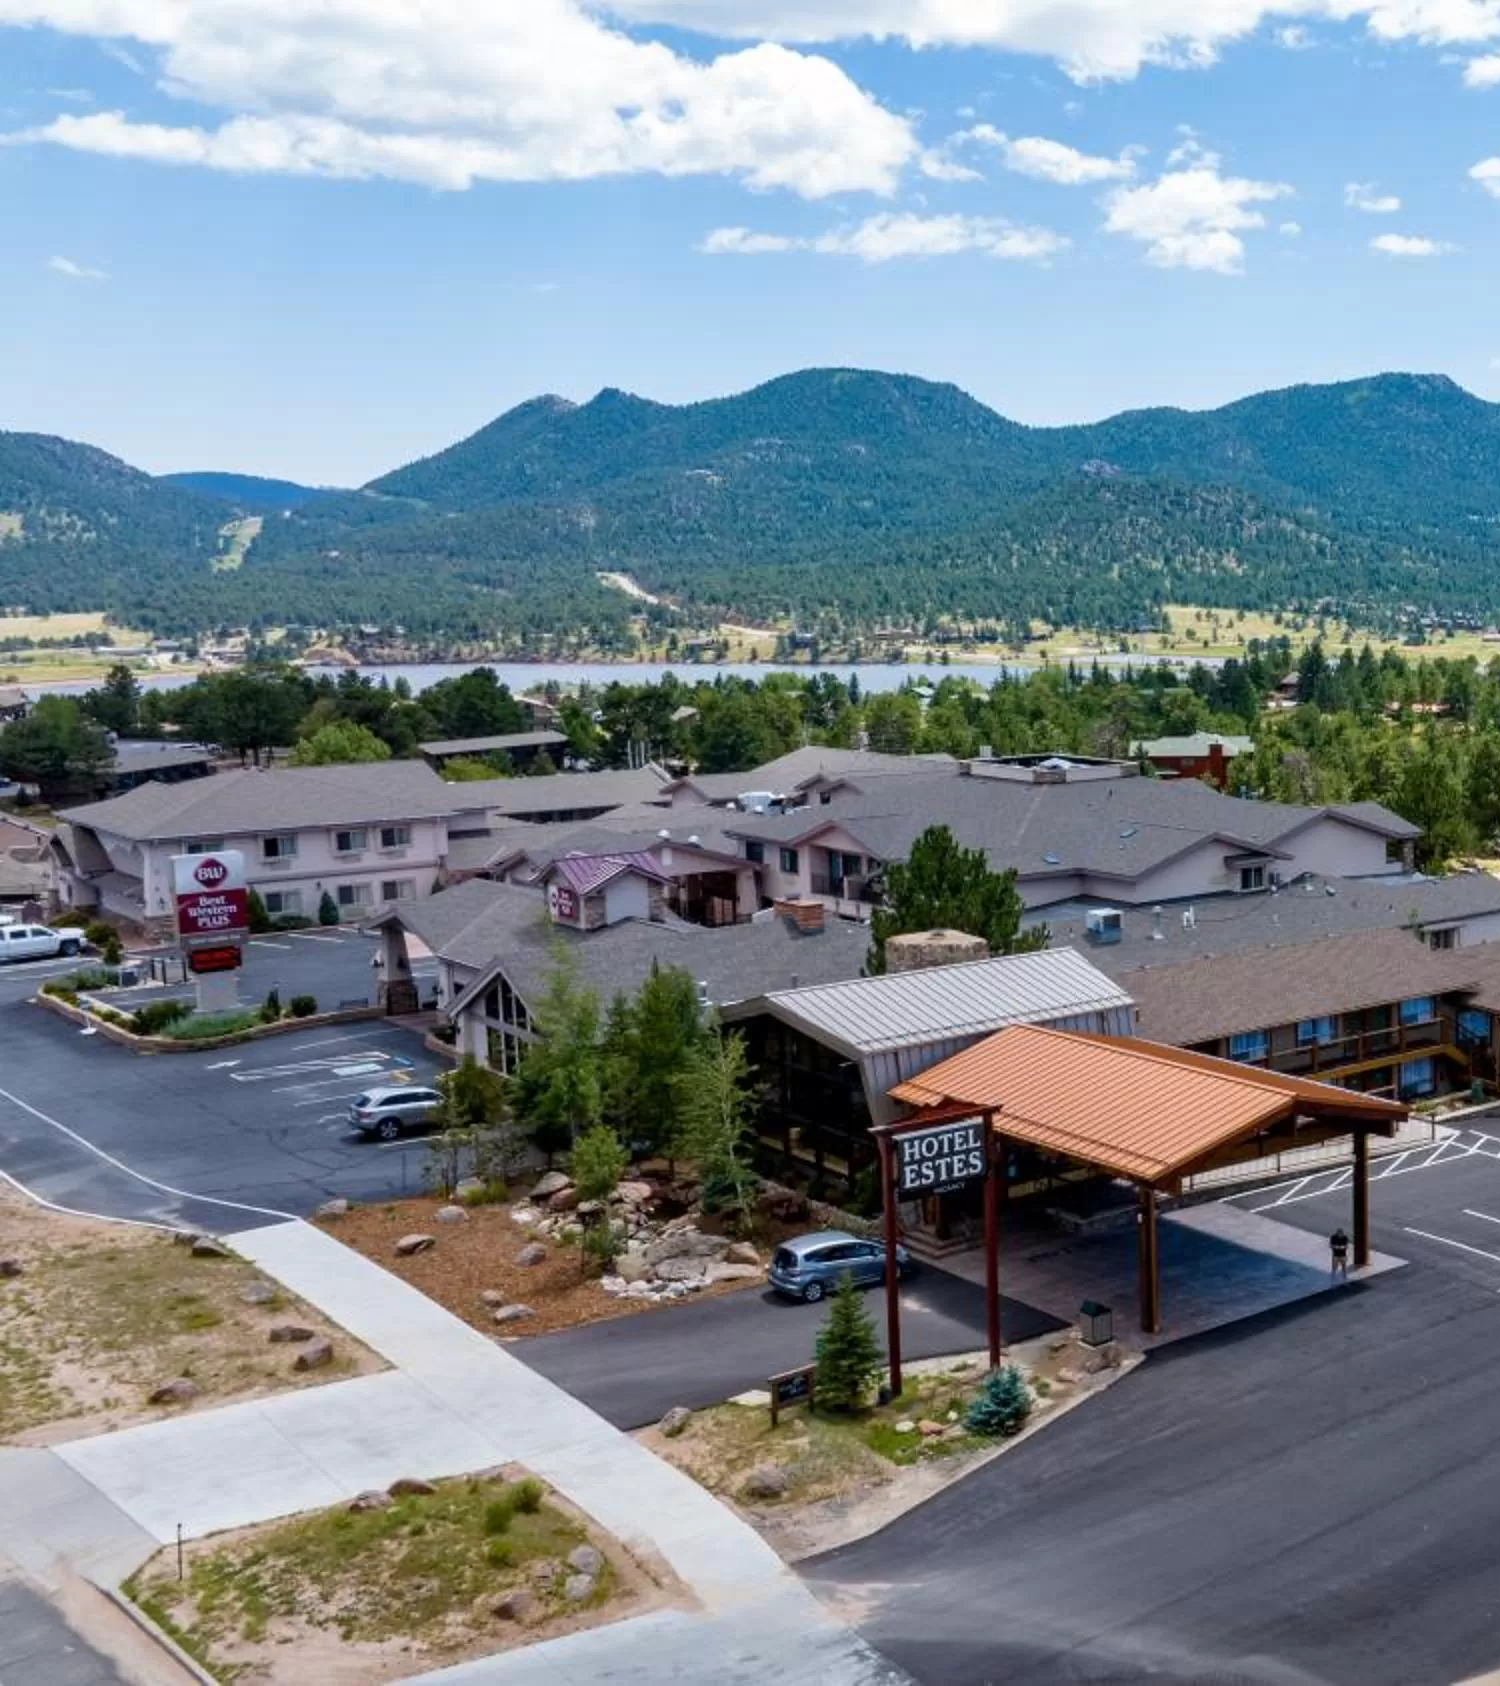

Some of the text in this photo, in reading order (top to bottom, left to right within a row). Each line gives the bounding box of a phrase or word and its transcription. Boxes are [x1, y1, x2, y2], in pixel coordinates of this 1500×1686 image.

[198, 867, 223, 881] BW
[199, 896, 225, 907] Best
[188, 904, 237, 918] Western
[903, 1129, 981, 1162] HOTEL
[904, 1152, 982, 1189] ESTES
